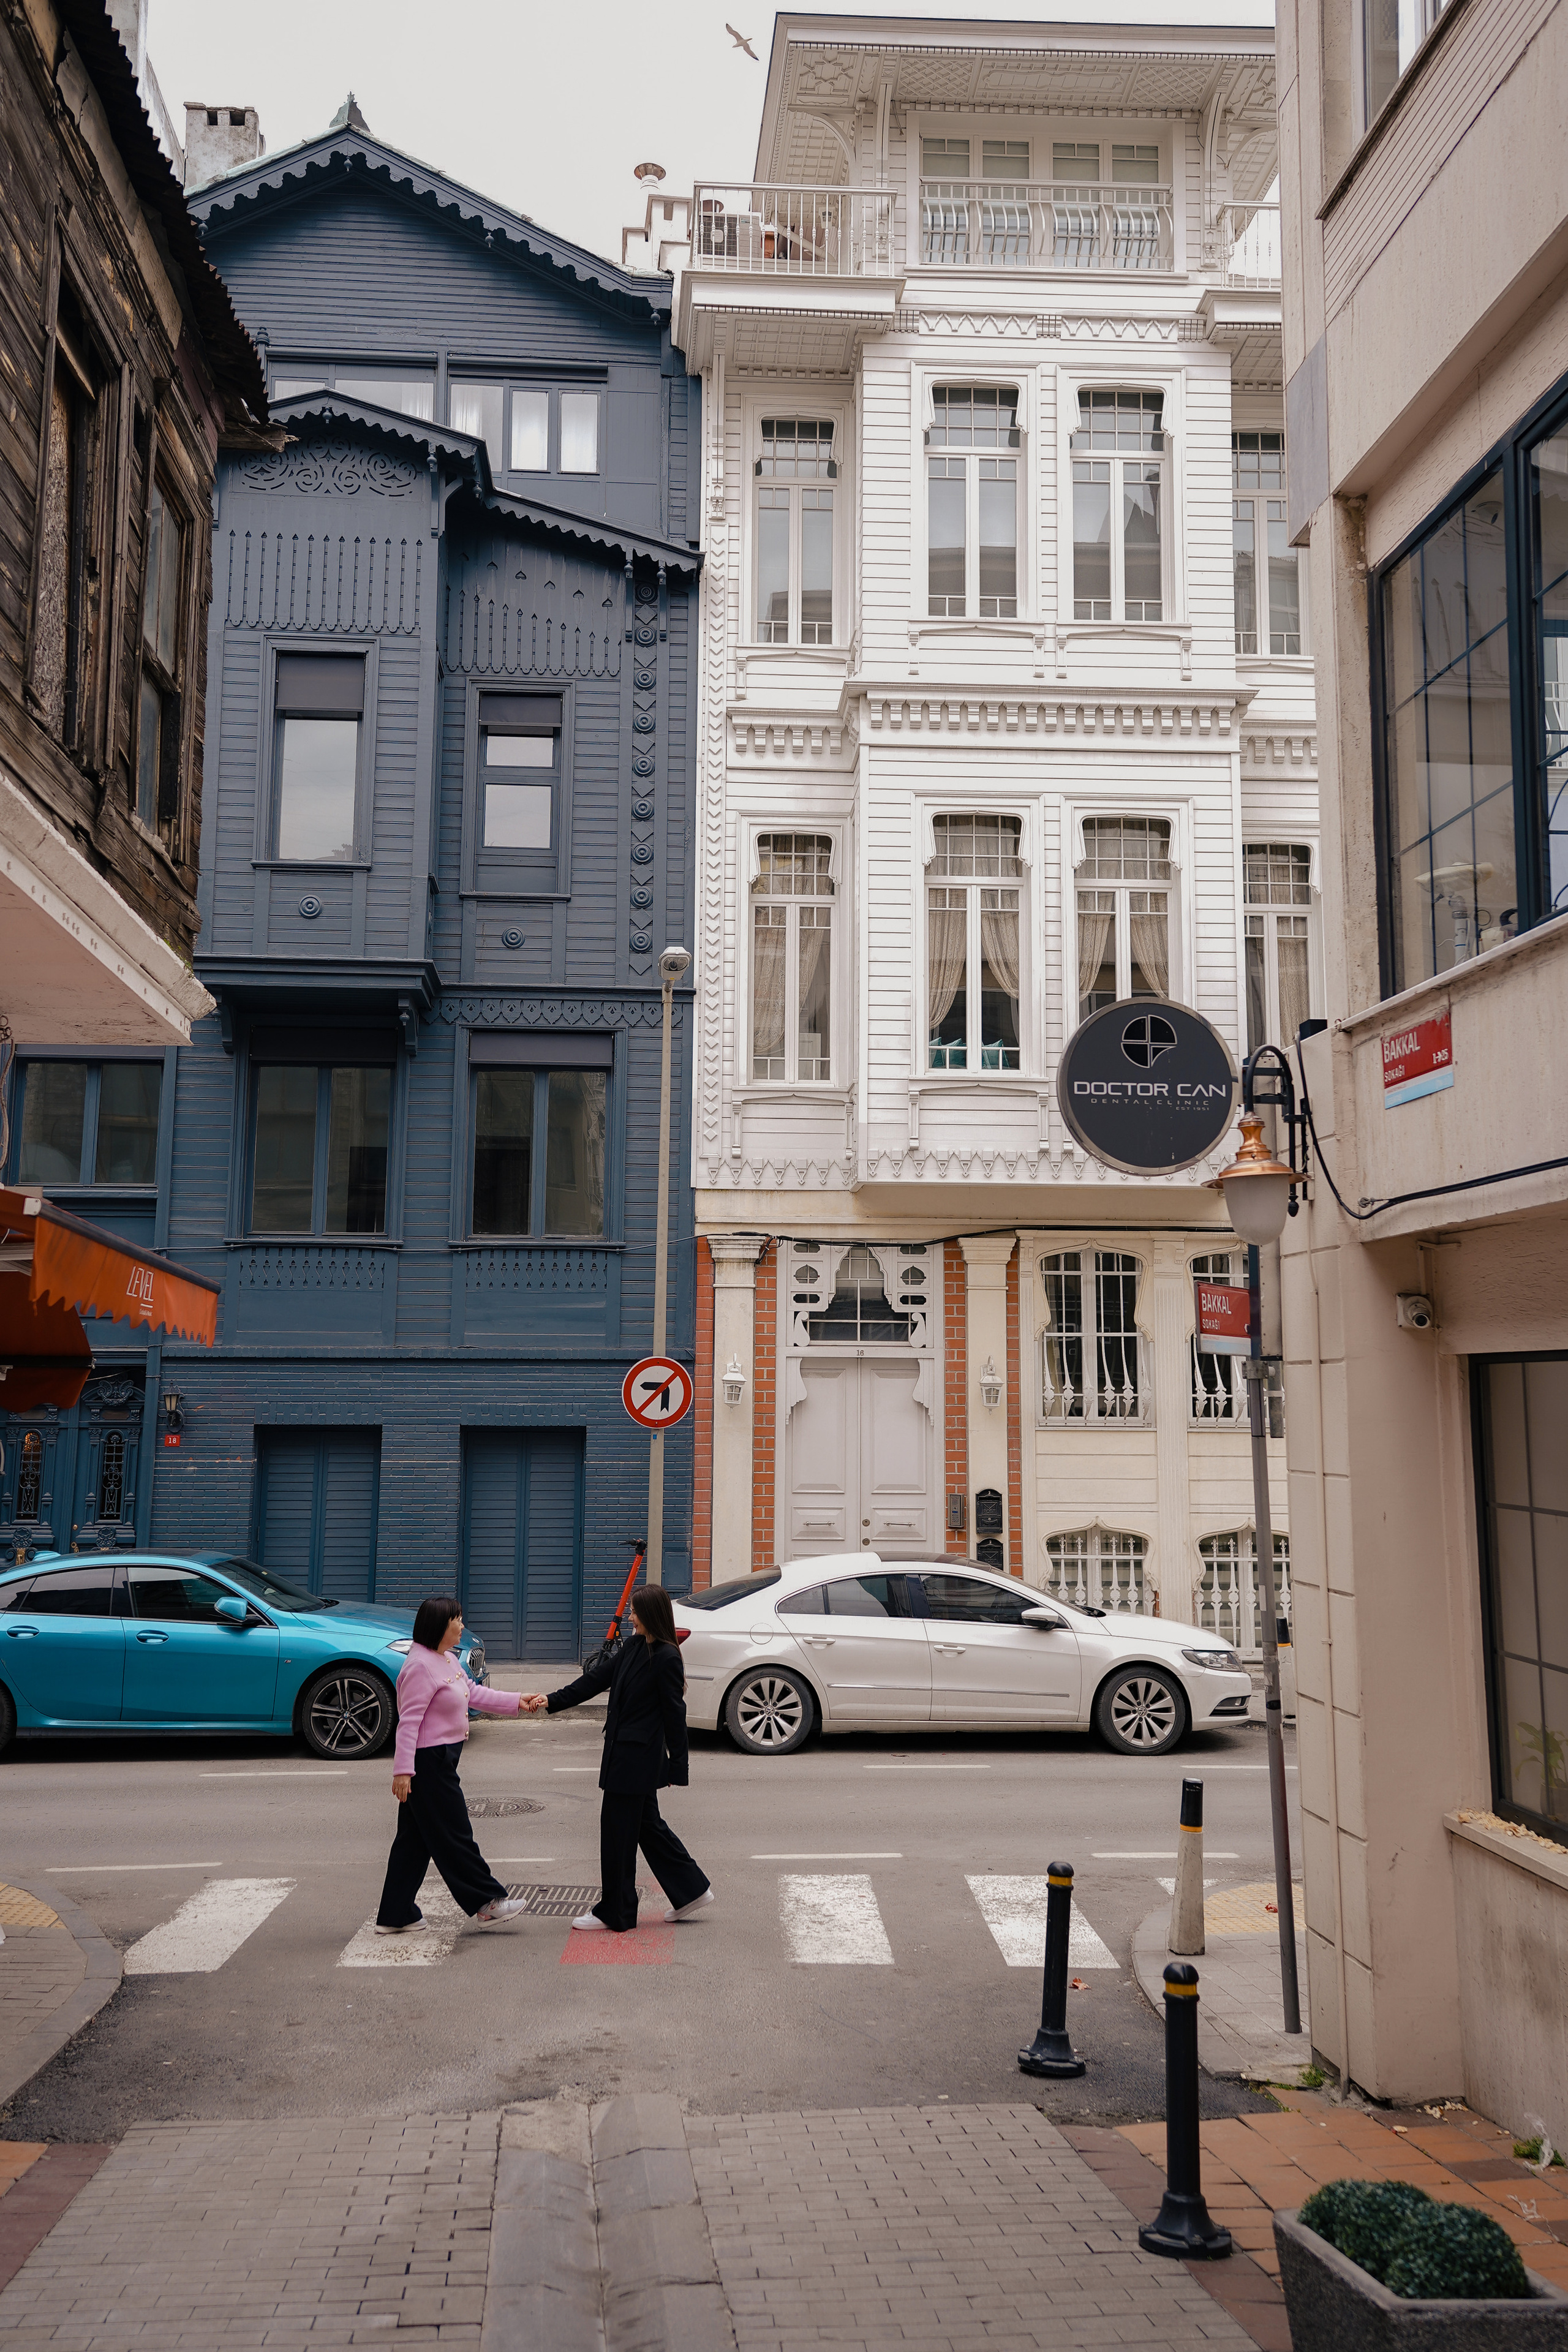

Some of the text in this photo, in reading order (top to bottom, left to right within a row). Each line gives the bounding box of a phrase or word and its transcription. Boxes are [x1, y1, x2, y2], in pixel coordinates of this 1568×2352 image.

[1384, 1031, 1421, 1063] BAKKAL
[1384, 1064, 1405, 1082] SOKAĞI
[1074, 1081, 1226, 1098] DOCTOR CAN
[126, 1266, 154, 1302] LEVEL
[1201, 1293, 1232, 1314] BAKKAL
[1202, 1318, 1221, 1330] SOKAĞI
